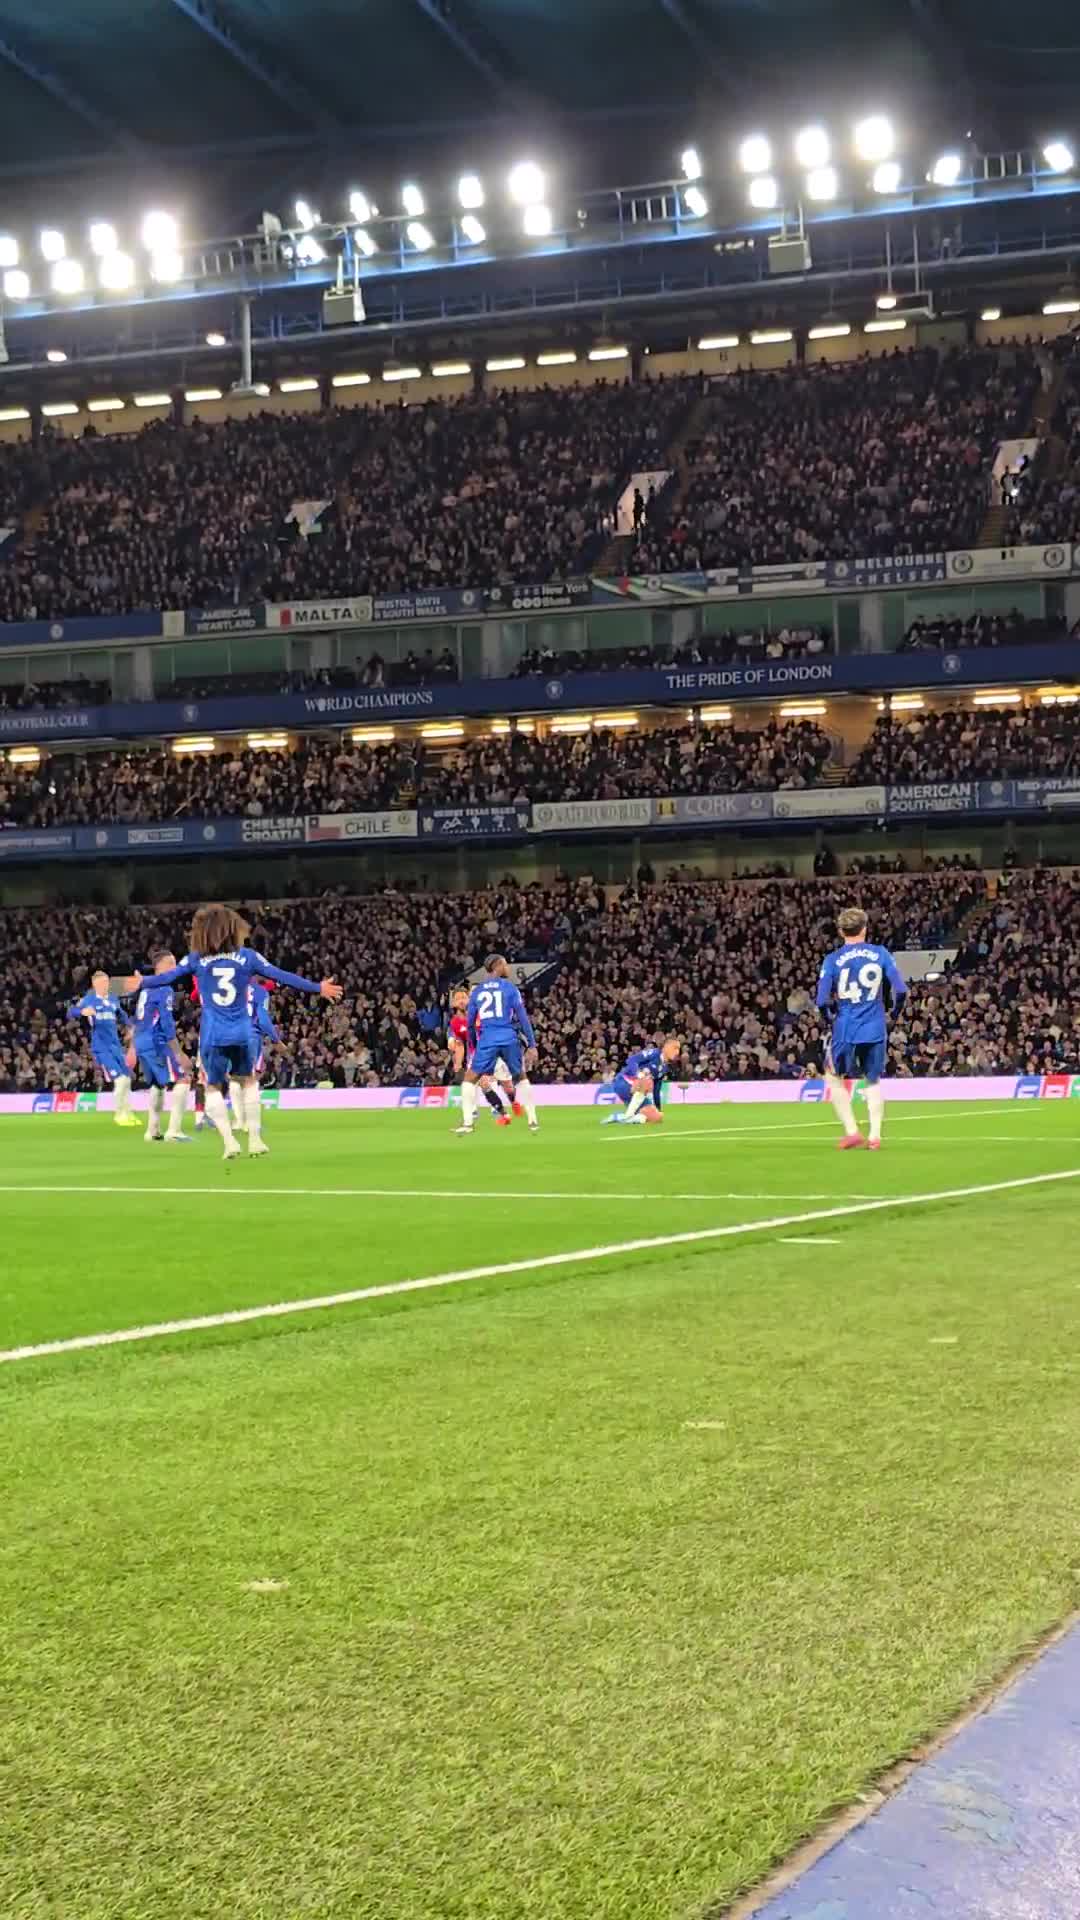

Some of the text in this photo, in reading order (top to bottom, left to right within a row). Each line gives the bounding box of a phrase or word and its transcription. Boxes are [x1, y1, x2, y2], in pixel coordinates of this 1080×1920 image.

[855, 553, 944, 569] MELBOURNE
[856, 569, 944, 585] CHELSEA
[201, 608, 250, 620] AMERICAN
[295, 607, 352, 622] MALTA
[666, 664, 833, 689] THE PRIDE OF LONDON
[305, 691, 433, 712] WORLD CHAMPIONS
[889, 783, 971, 801] AMERICAN
[685, 796, 736, 817] CORK
[889, 798, 971, 812] SOUTHWEST
[242, 817, 304, 831] CHELSEA
[345, 820, 391, 834] CHILE
[242, 829, 301, 842] CROATIA
[928, 952, 937, 966] 7
[516, 967, 526, 980] 6
[211, 967, 237, 1007] 3
[838, 963, 882, 1004] 49
[477, 991, 503, 1020] 21
